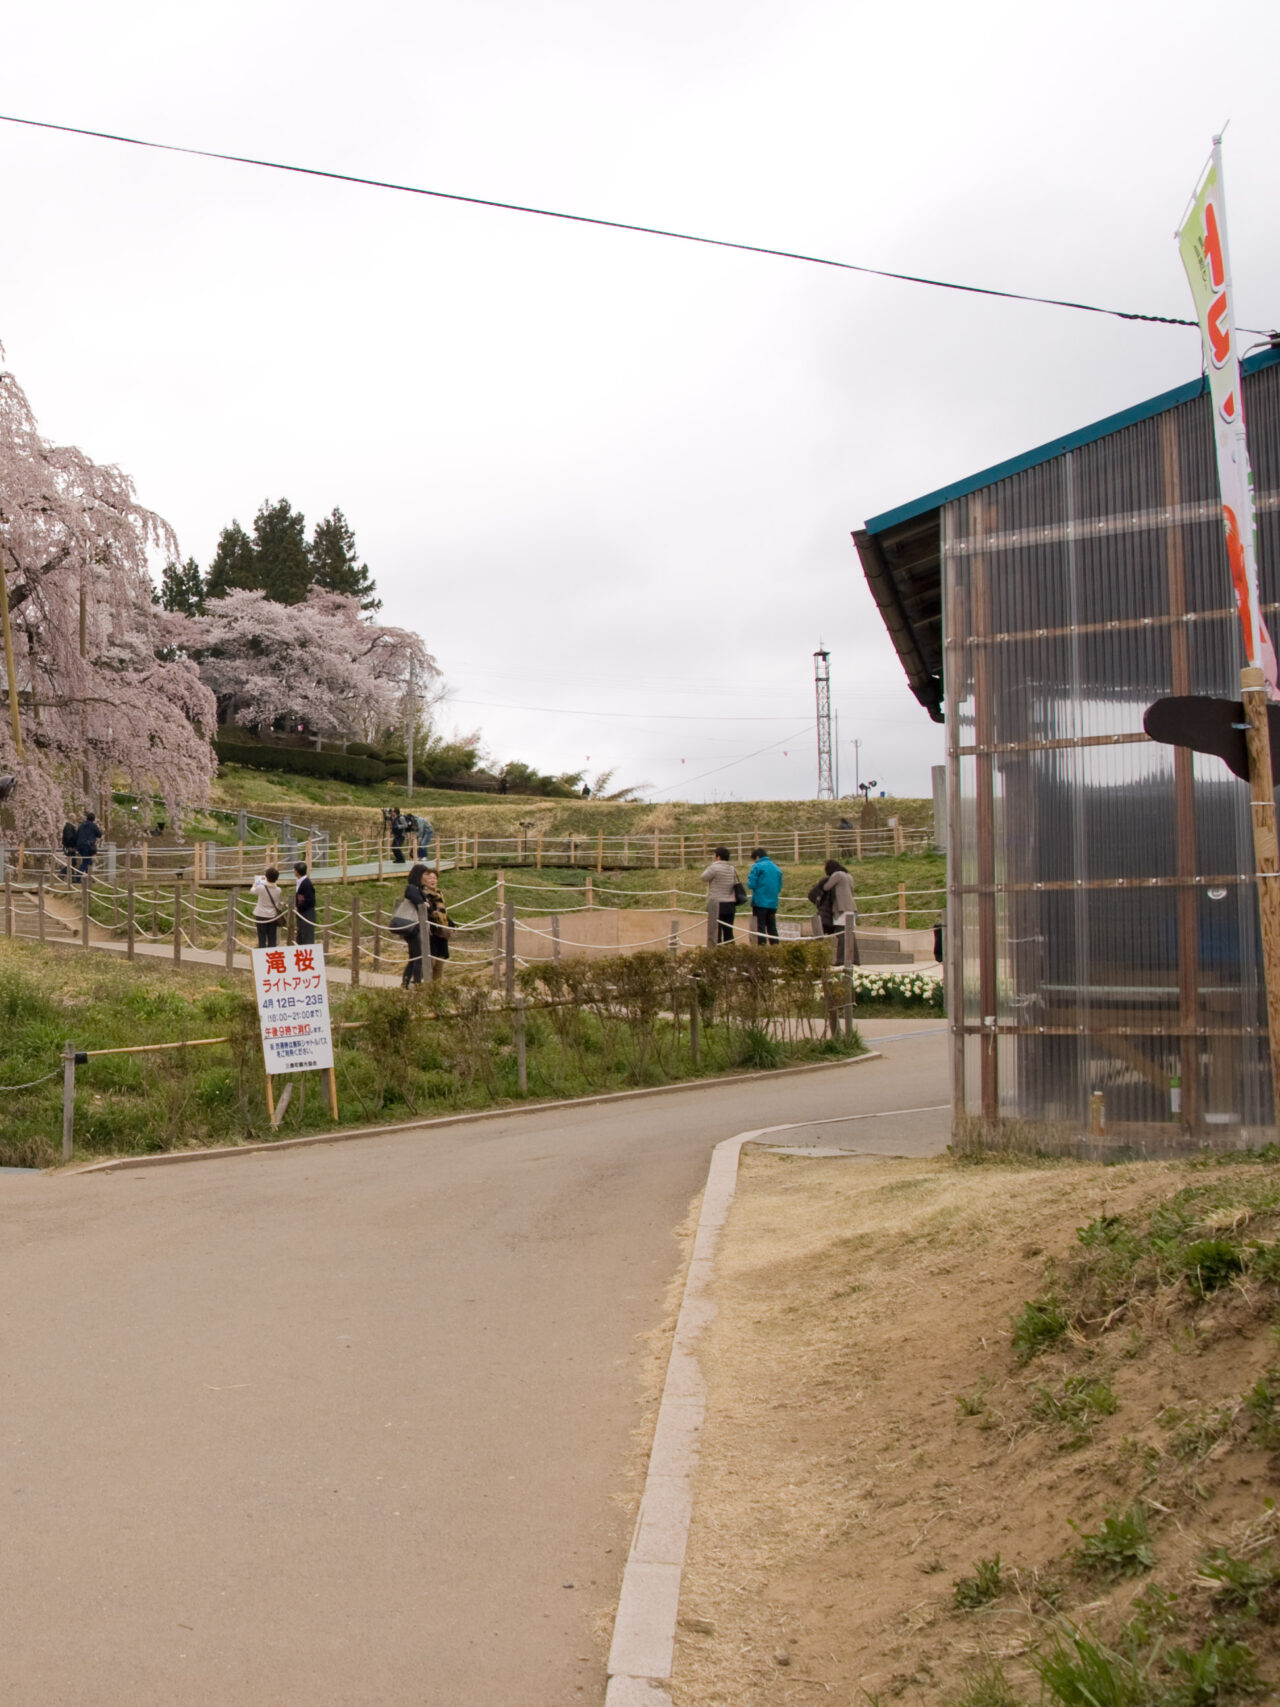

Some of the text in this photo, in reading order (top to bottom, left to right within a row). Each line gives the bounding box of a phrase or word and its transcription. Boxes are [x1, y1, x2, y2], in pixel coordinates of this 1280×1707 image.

[265, 949, 315, 975] 滝桜
[262, 975, 321, 993] ライトアップ
